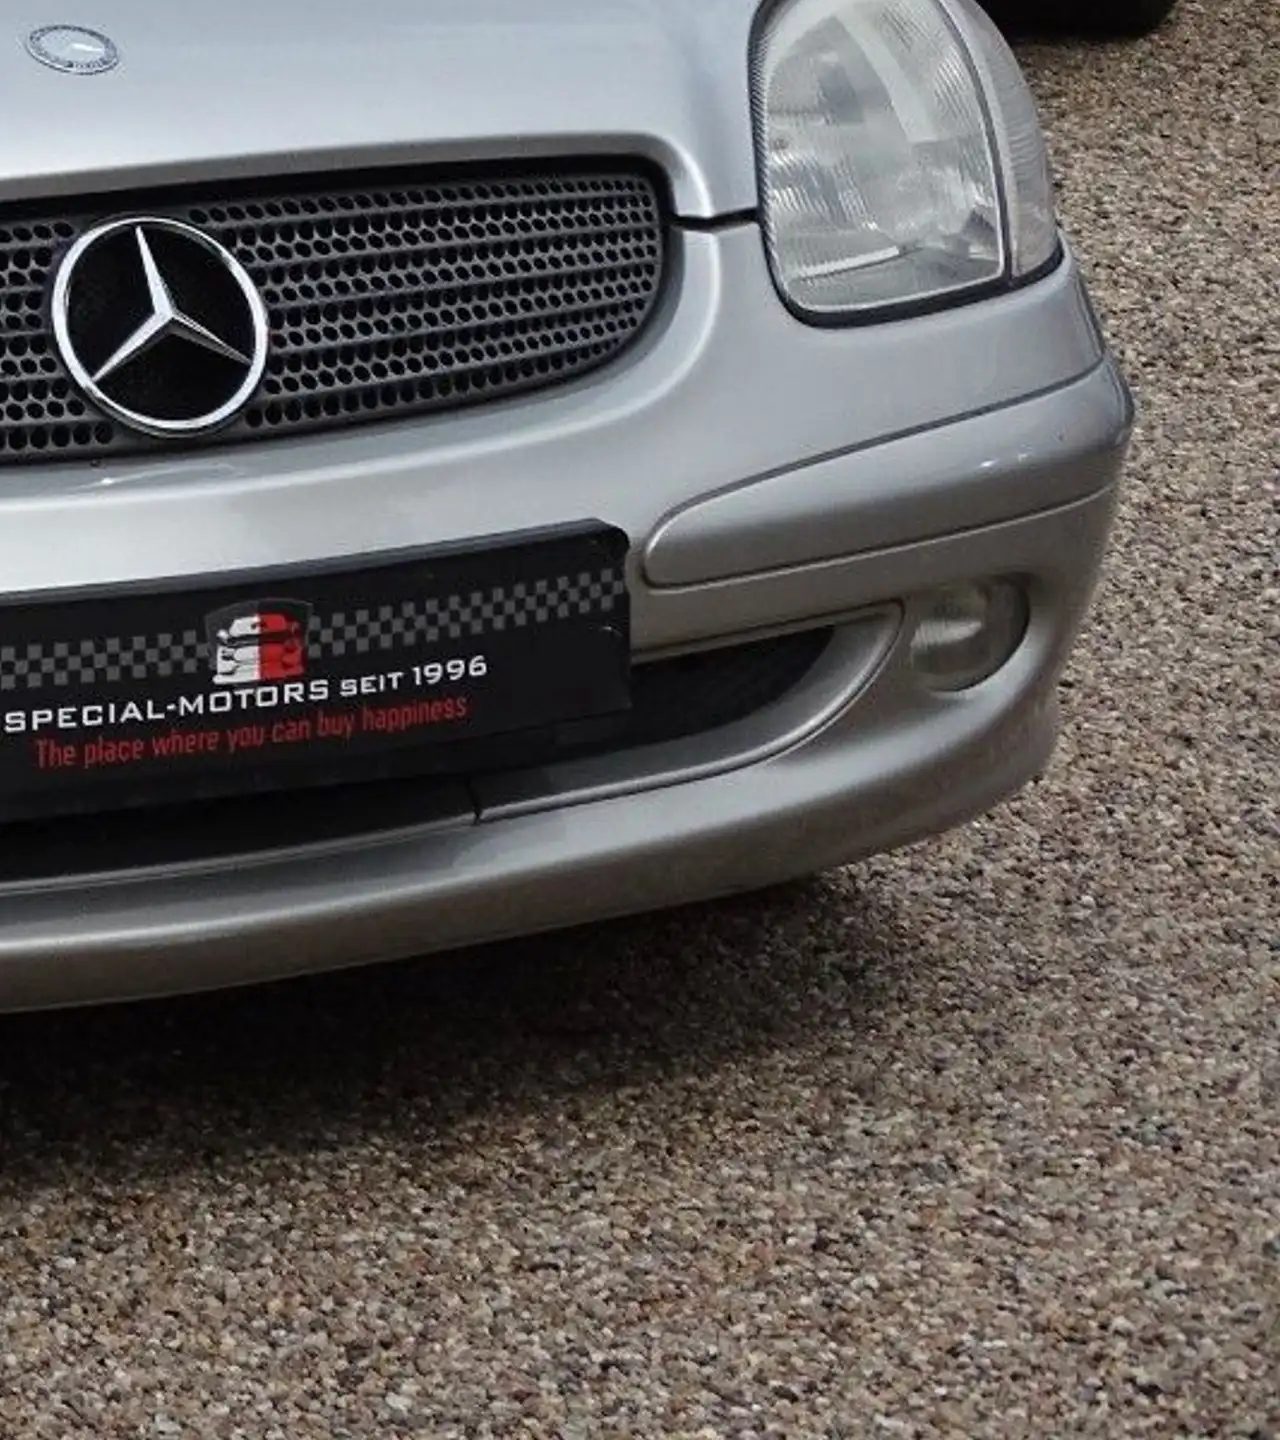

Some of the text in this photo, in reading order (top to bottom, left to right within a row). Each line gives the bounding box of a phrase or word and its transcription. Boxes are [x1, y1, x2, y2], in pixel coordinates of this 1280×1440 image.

[4, 655, 487, 734] SPECIAL-MOTORS SEIT 1996
[37, 696, 467, 768] The place where you can buy happiness
